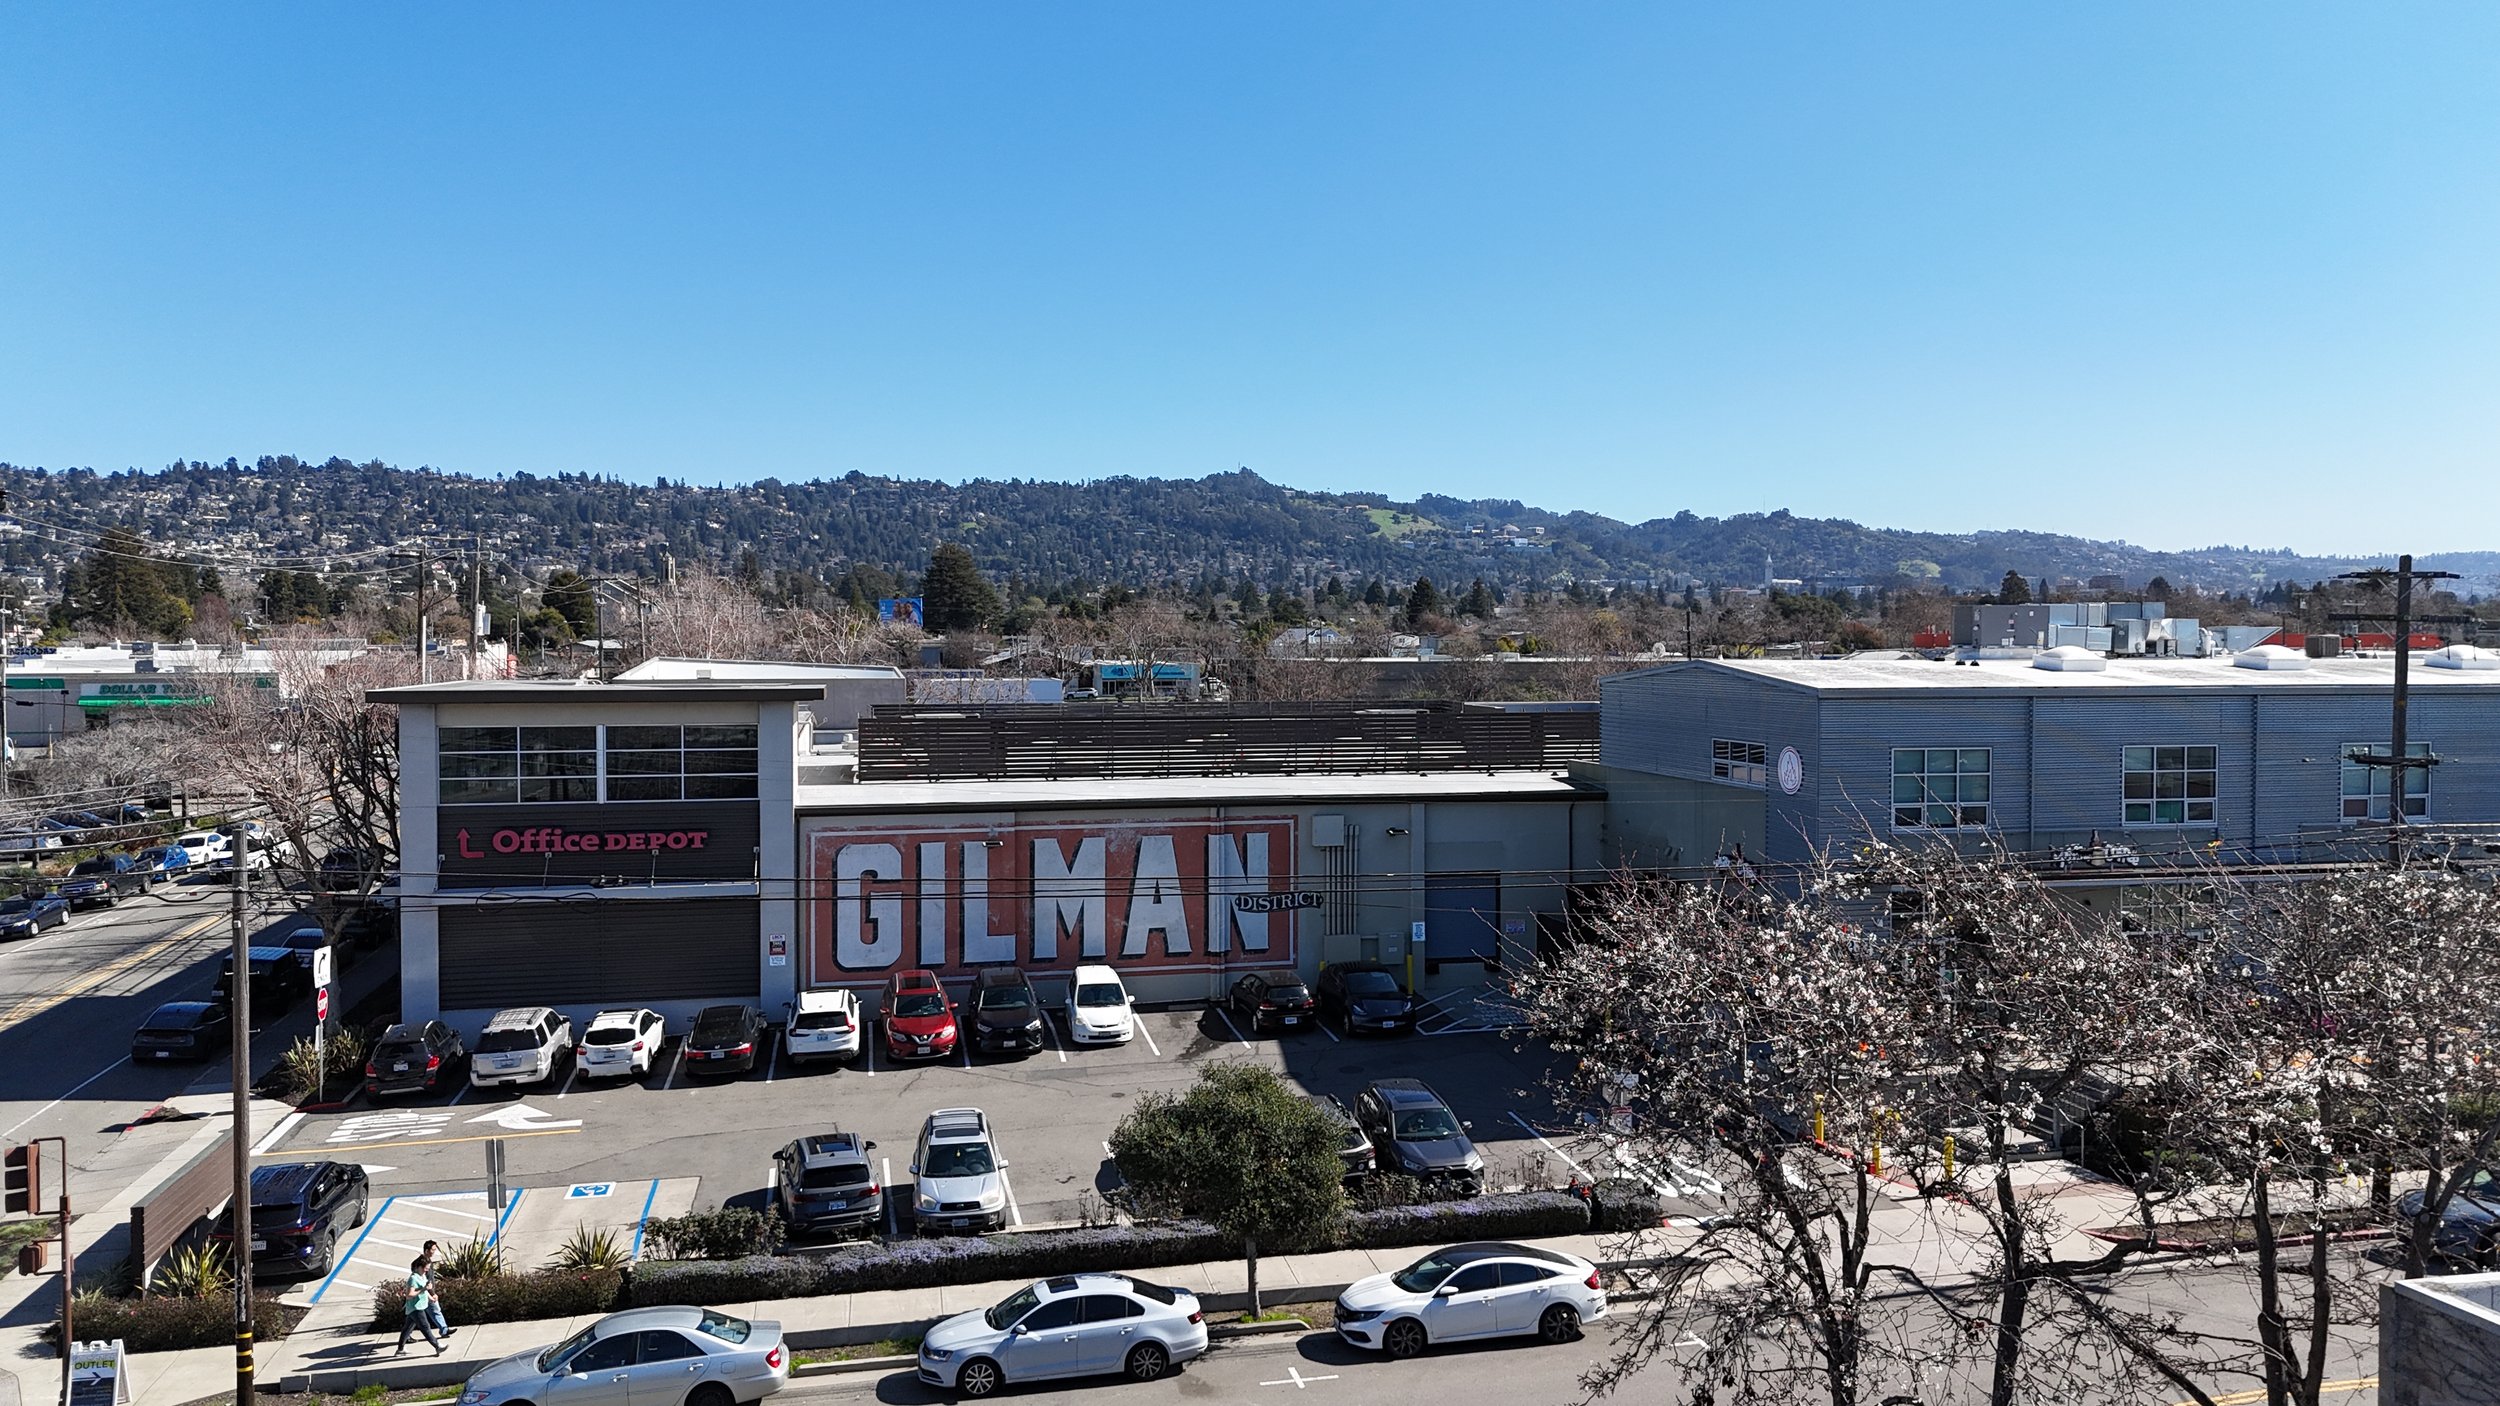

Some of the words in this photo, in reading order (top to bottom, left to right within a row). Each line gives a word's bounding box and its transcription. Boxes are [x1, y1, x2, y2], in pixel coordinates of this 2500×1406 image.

[99, 684, 157, 695] DOLLAR
[492, 828, 600, 854] Office
[604, 831, 708, 851] DEPOT
[835, 833, 1270, 970] GILMAN
[1239, 892, 1321, 911] DISTRICT
[74, 1360, 116, 1370] OUTLET
